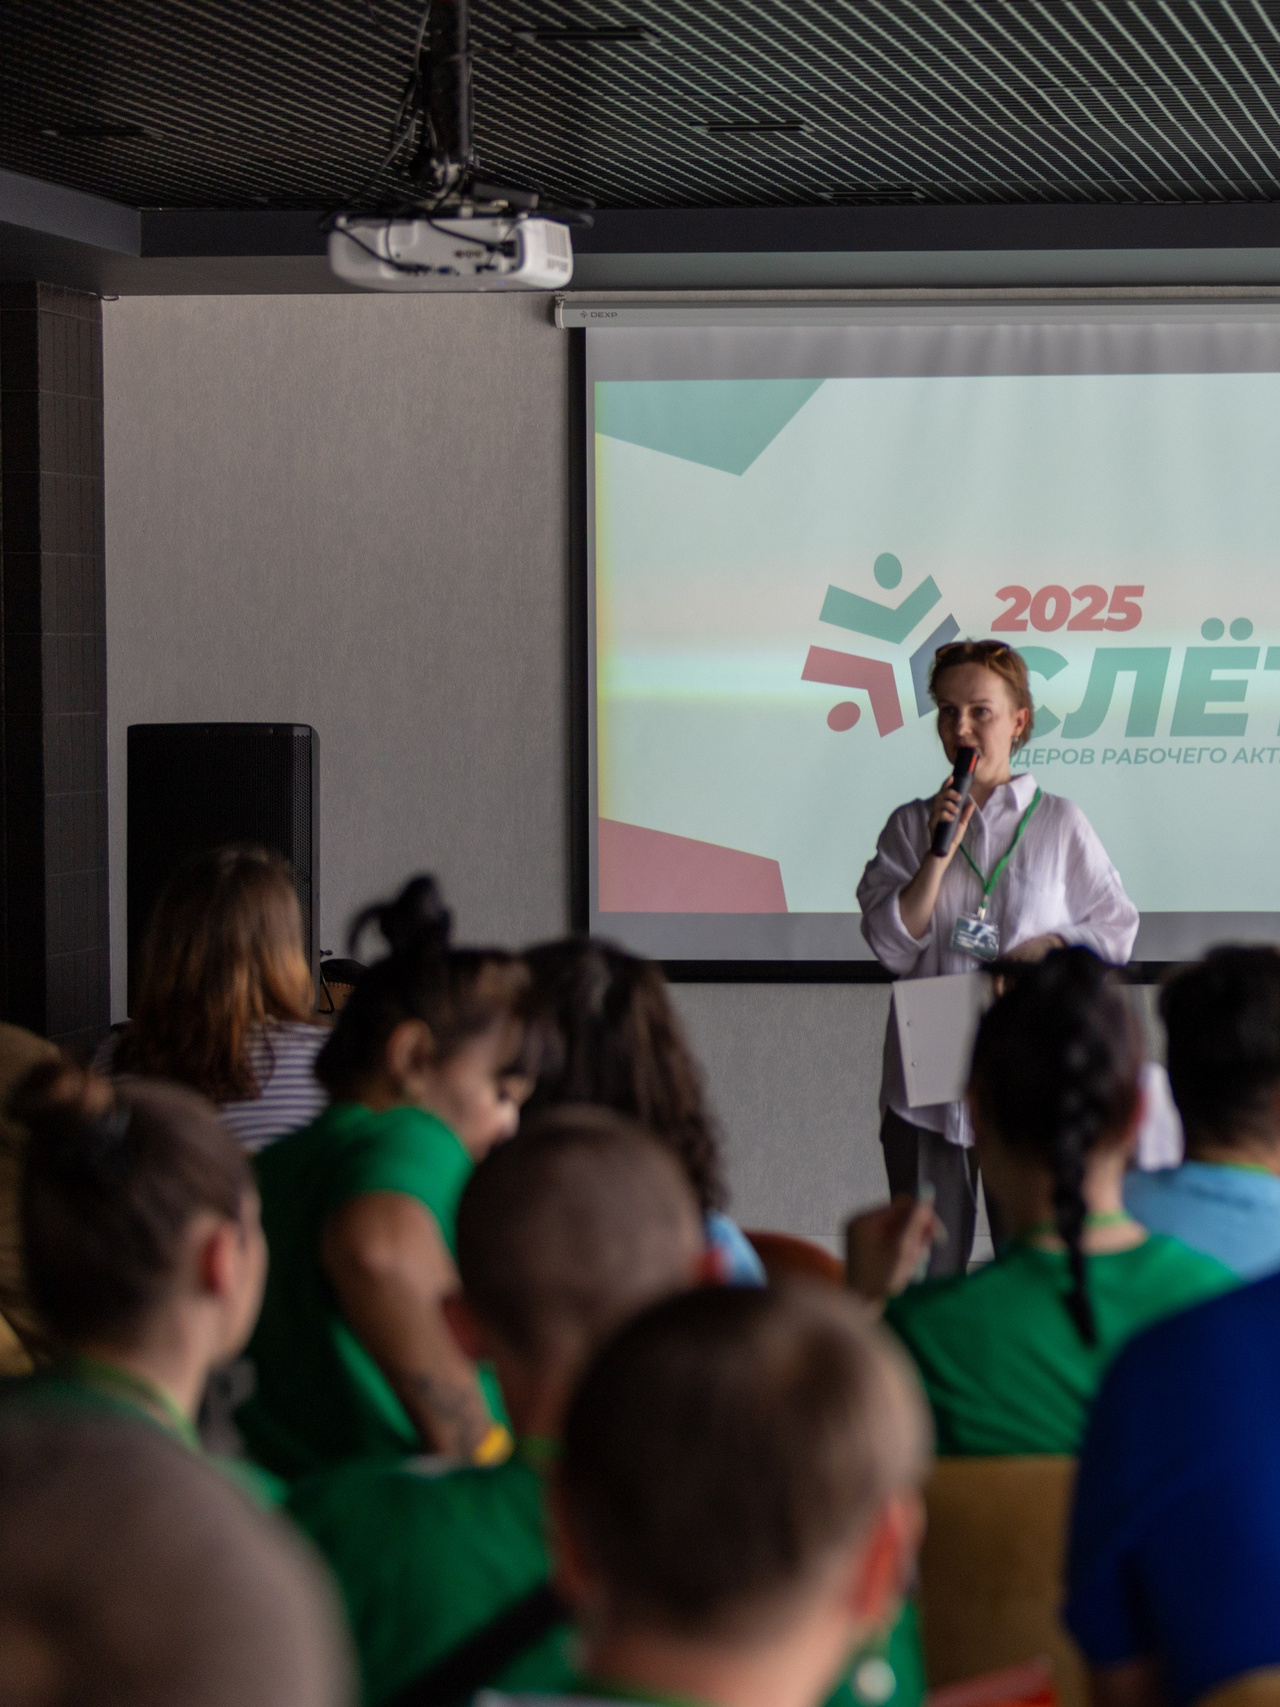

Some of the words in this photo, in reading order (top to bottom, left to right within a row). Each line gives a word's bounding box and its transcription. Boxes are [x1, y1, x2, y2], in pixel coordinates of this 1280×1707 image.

[590, 311, 618, 319] DEXP
[990, 585, 1145, 632] 2025
[1009, 748, 1095, 768] ДЕРОВ
[1101, 747, 1227, 765] РАБОЧЕГО
